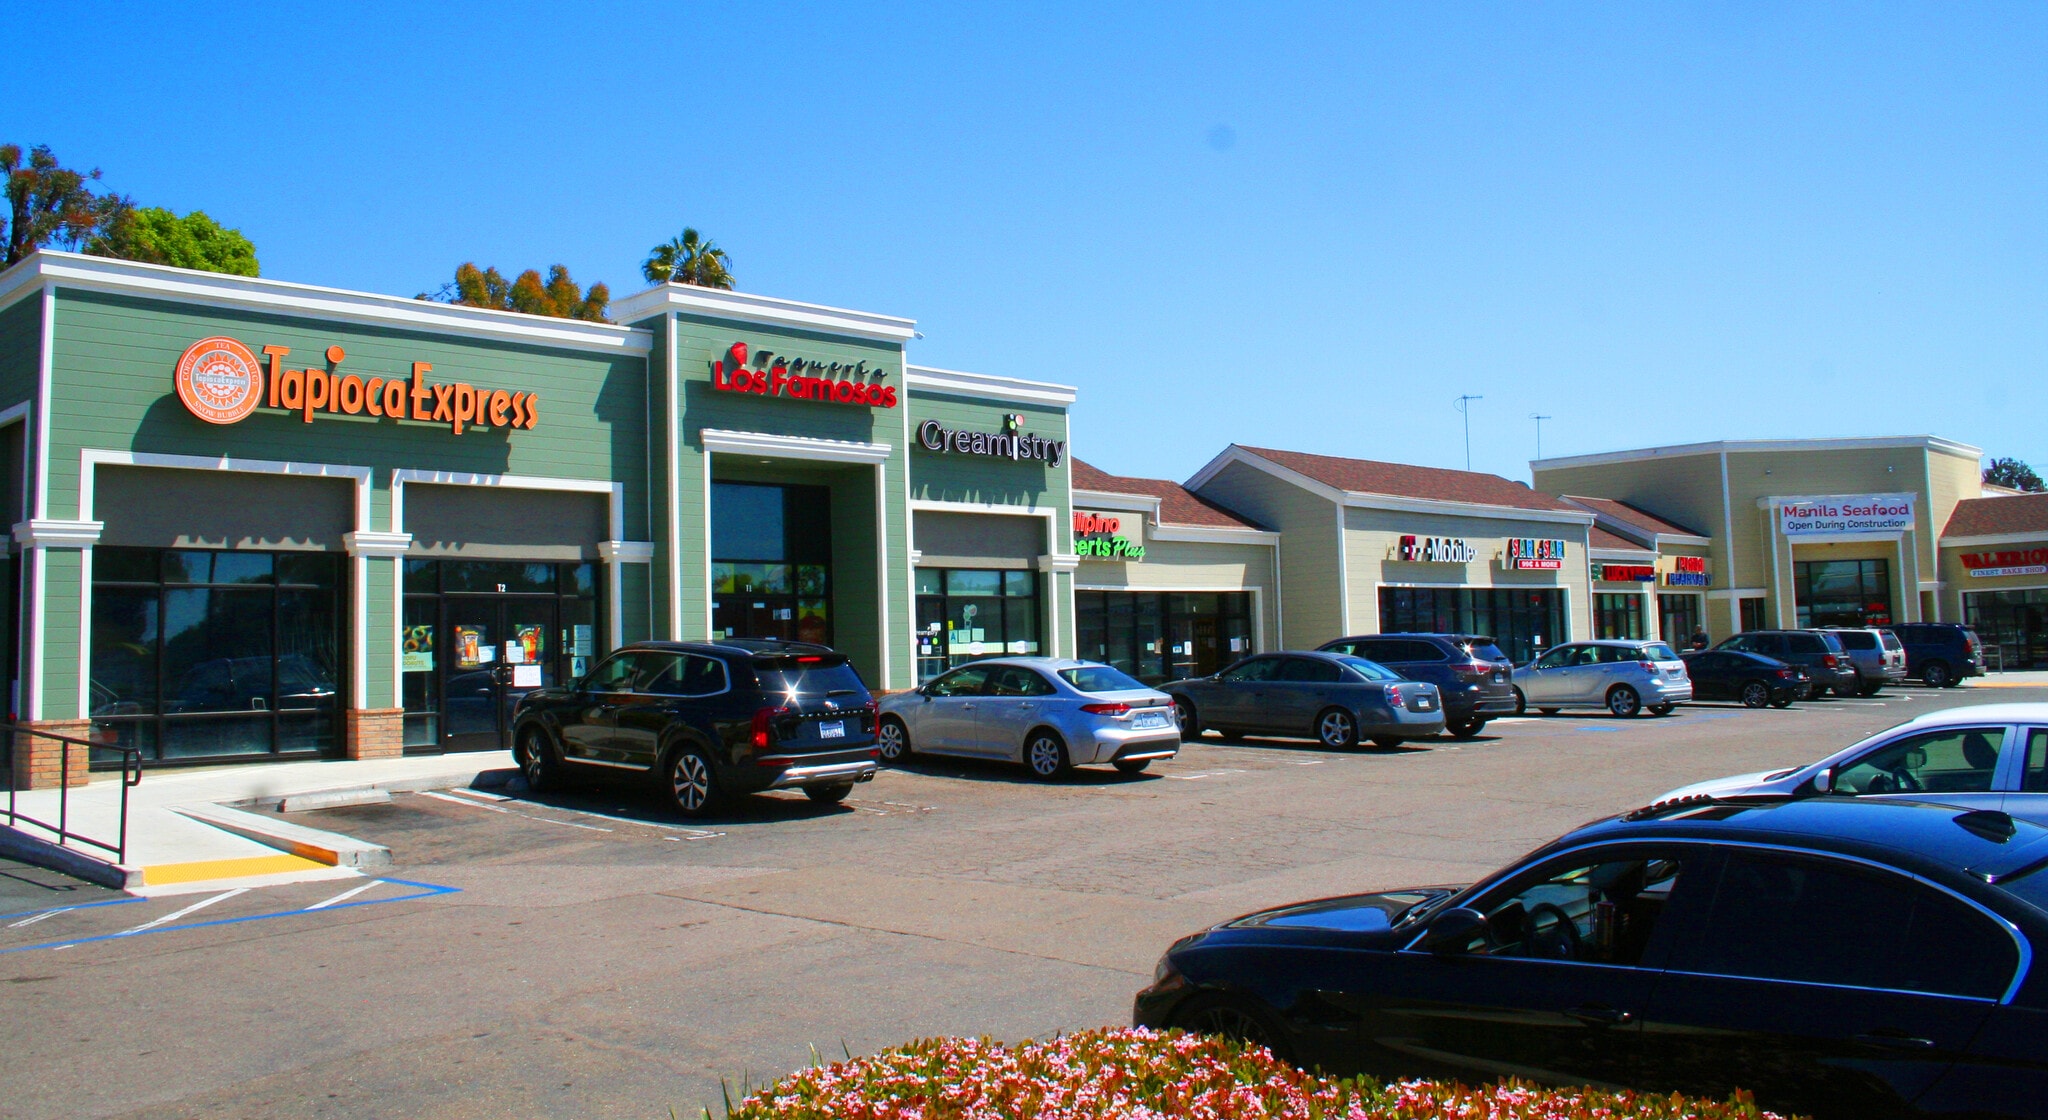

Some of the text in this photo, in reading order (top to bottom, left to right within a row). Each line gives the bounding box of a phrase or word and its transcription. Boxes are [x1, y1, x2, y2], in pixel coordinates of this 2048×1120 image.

[215, 342, 230, 350] TEA
[714, 360, 897, 408] Los Famosos
[194, 400, 246, 418] SNOW BUBBLE
[919, 414, 1066, 468] Creamistry
[1784, 503, 1910, 518] Manila Seafood
[1073, 511, 1120, 537] ilipino
[1787, 519, 1906, 531] Open During Construction
[1074, 536, 1146, 557] erts Plus
[575, 660, 583, 669] A
